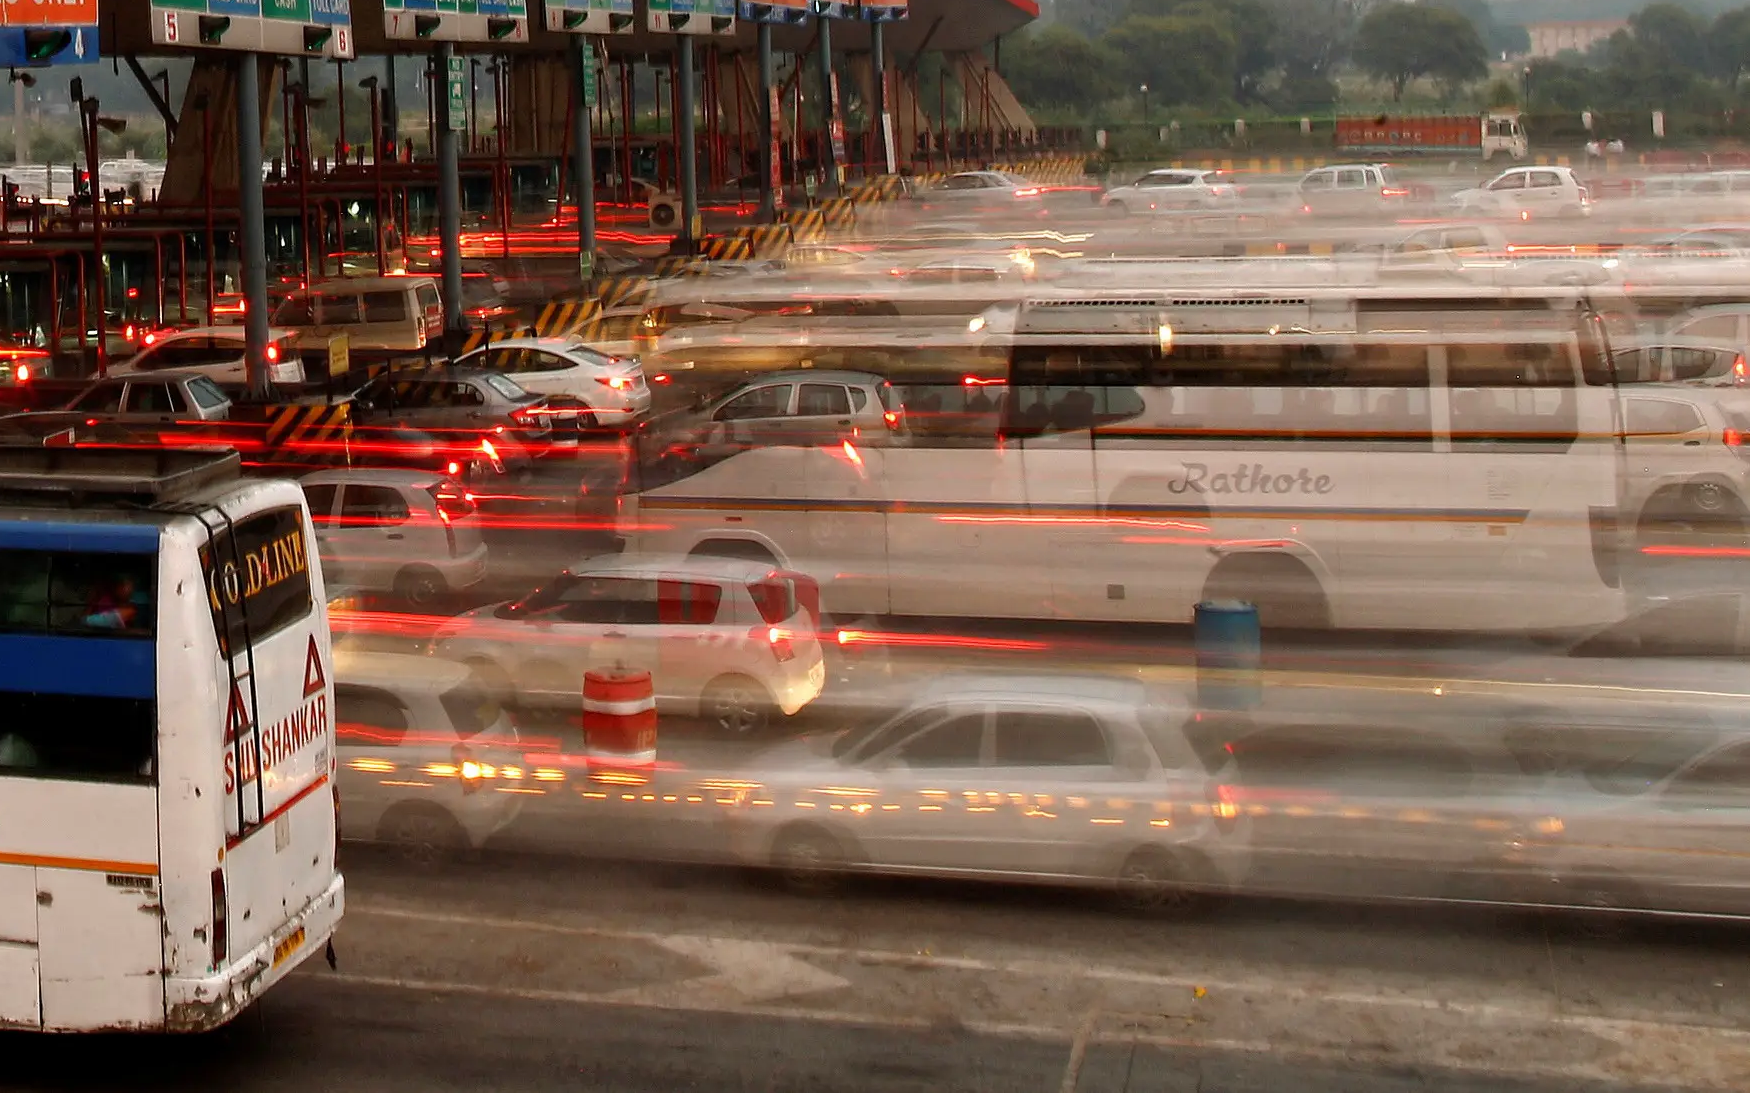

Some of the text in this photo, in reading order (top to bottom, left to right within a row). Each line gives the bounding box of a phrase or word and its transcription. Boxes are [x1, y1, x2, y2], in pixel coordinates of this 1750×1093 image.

[167, 14, 177, 42] 5
[393, 15, 399, 35] 7
[75, 28, 84, 59] 4
[1168, 461, 1336, 495] Rathore
[262, 694, 327, 772] SHANKAR
